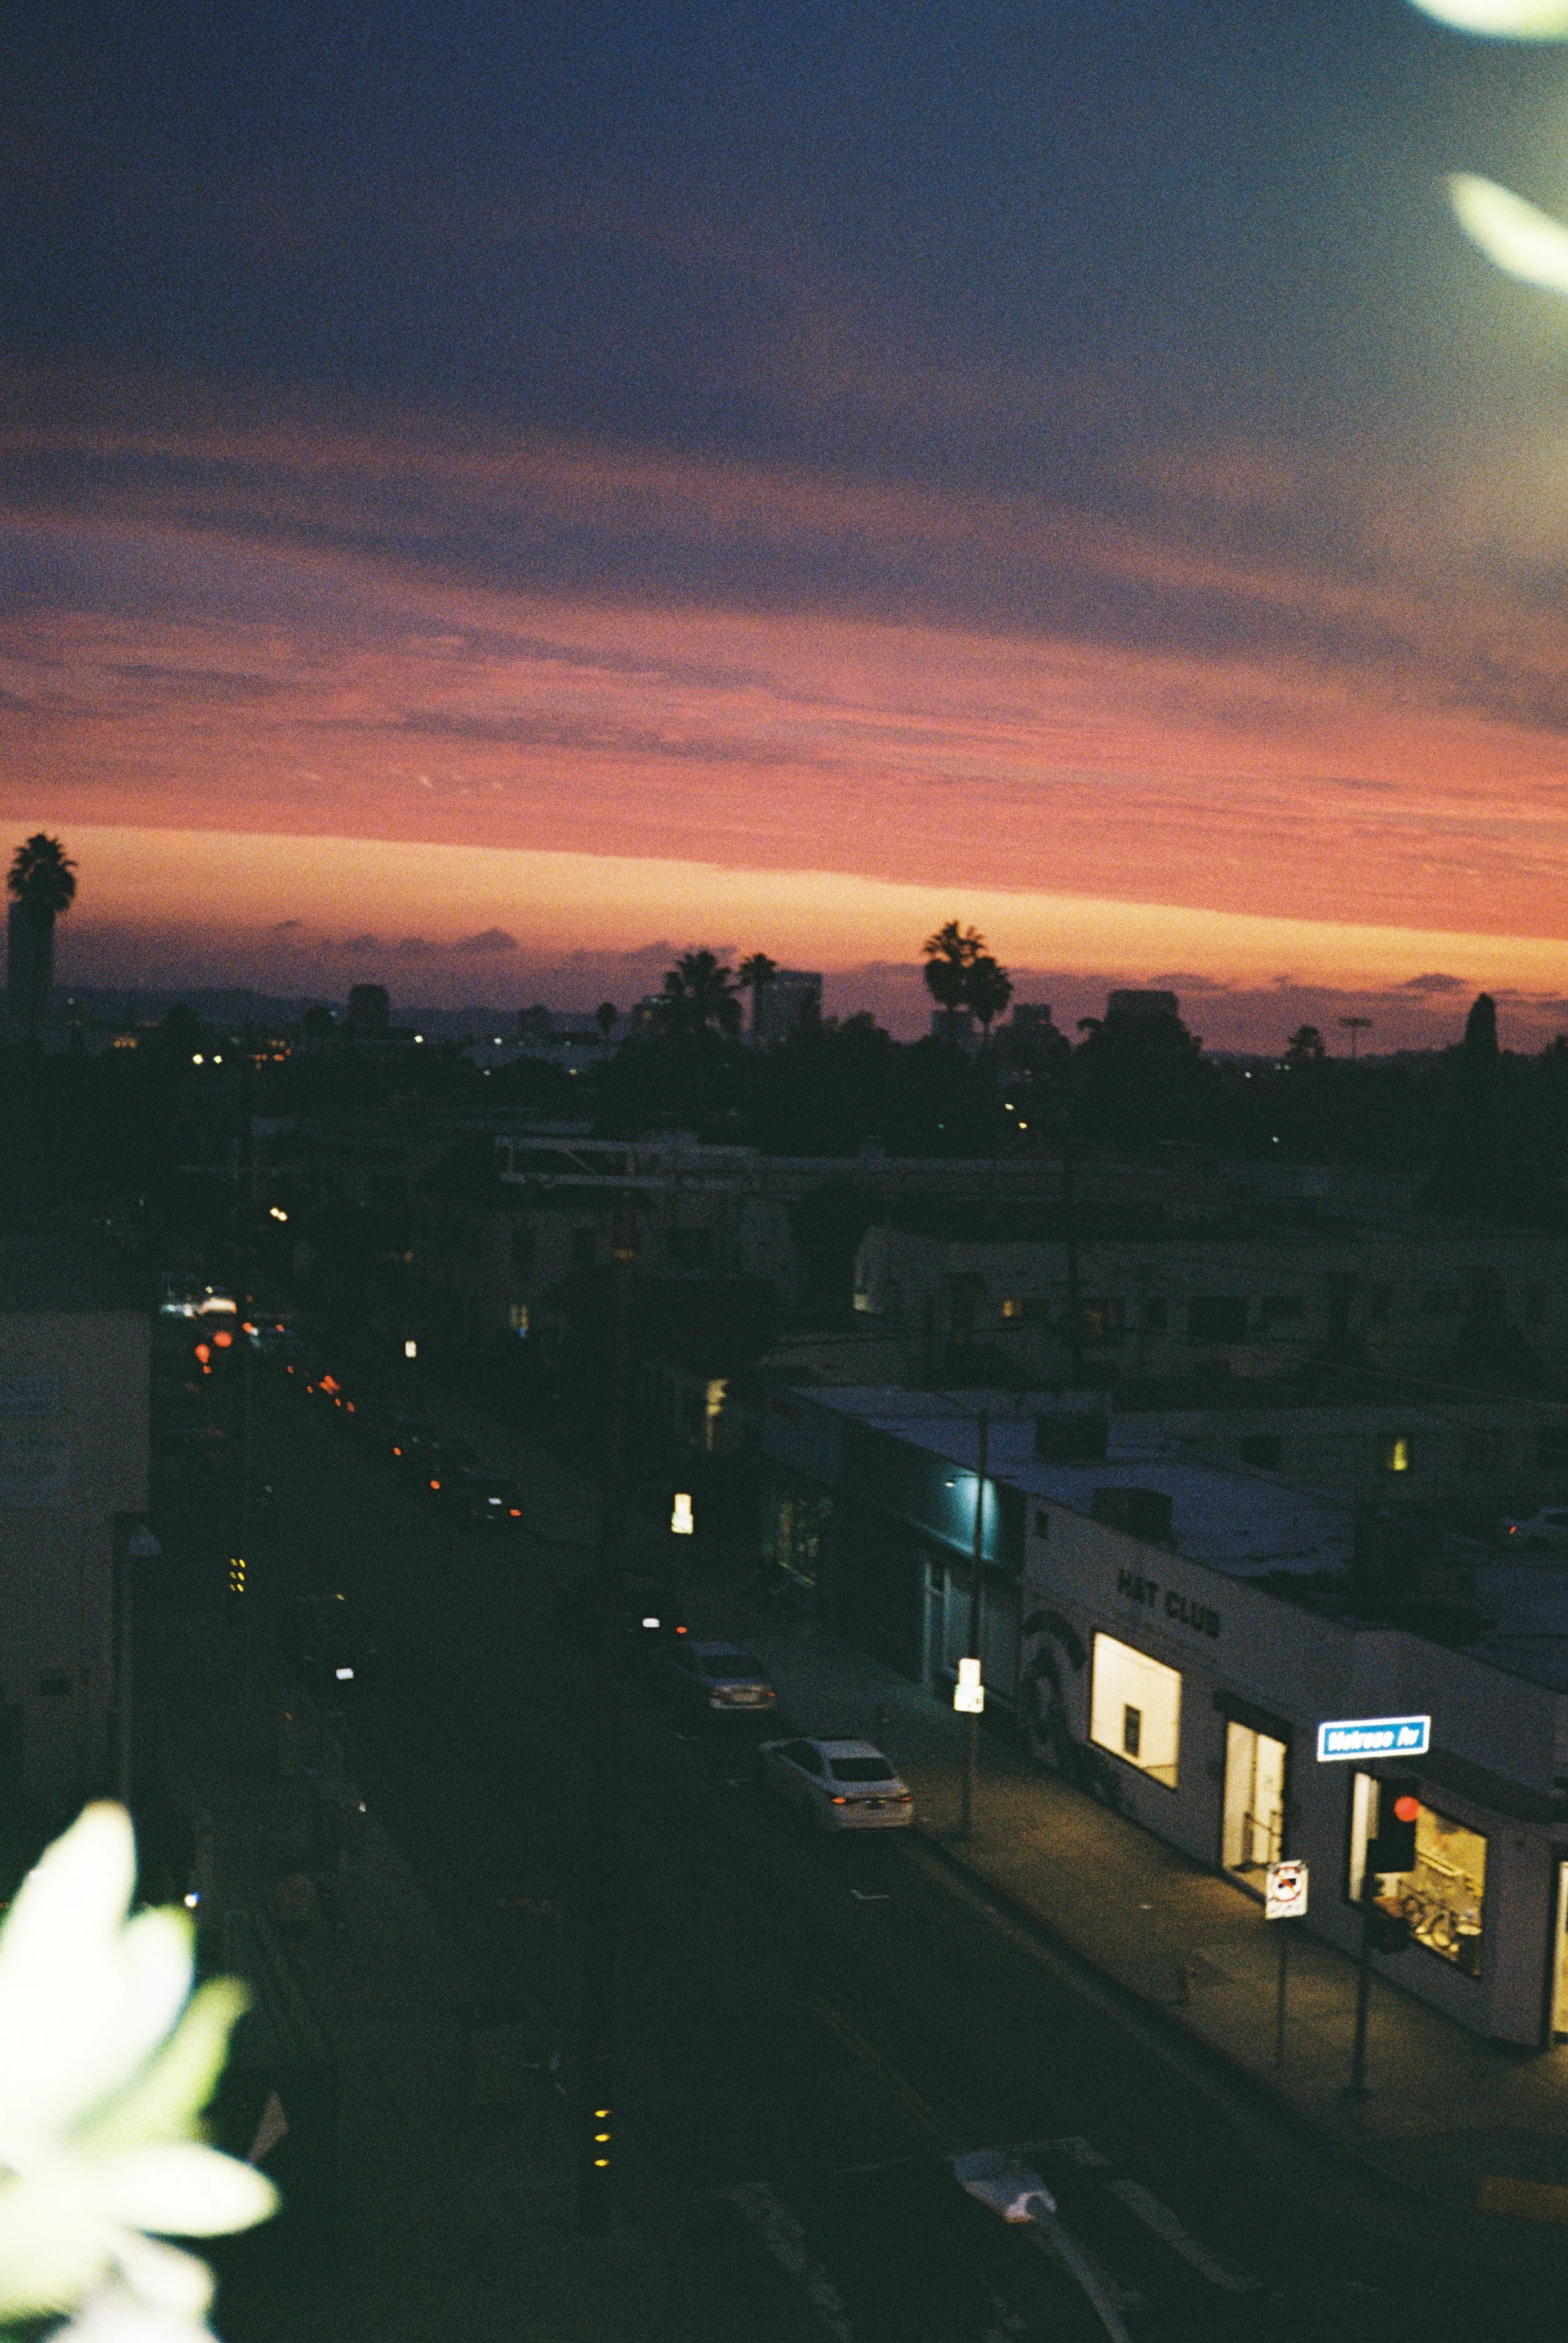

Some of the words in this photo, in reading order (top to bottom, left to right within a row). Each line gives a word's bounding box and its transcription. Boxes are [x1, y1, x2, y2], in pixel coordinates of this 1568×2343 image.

[1119, 1568, 1159, 1607] HAT
[1165, 1590, 1221, 1638] CLUB
[1328, 1730, 1394, 1751] Melrose
[1397, 1726, 1419, 1747] Av
